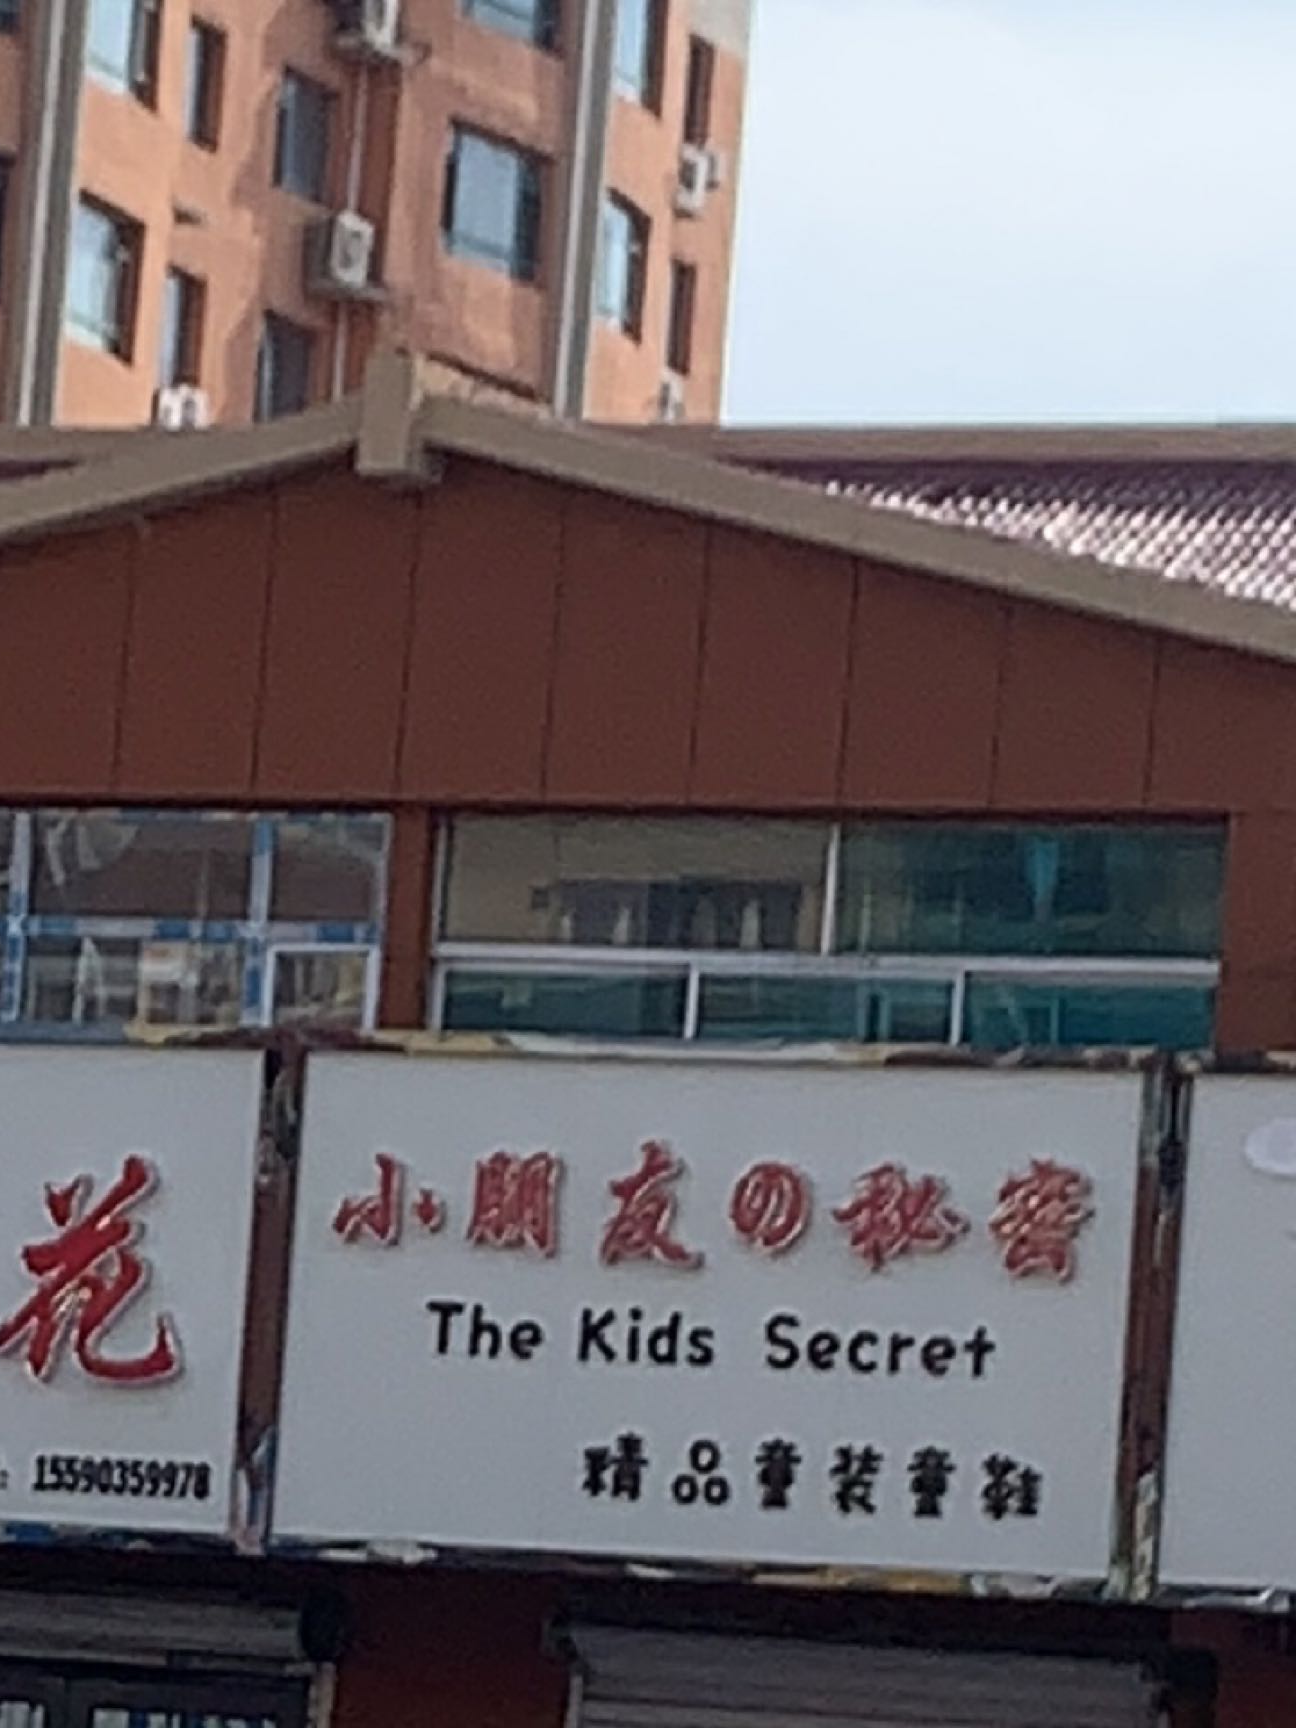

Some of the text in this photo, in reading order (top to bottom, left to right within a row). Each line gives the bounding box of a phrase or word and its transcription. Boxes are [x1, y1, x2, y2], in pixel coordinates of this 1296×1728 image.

[332, 1141, 1096, 1286] 小朋友の秘密
[426, 1302, 998, 1378] The Kids Secret
[581, 1432, 1045, 1521] 精品童装童鞋
